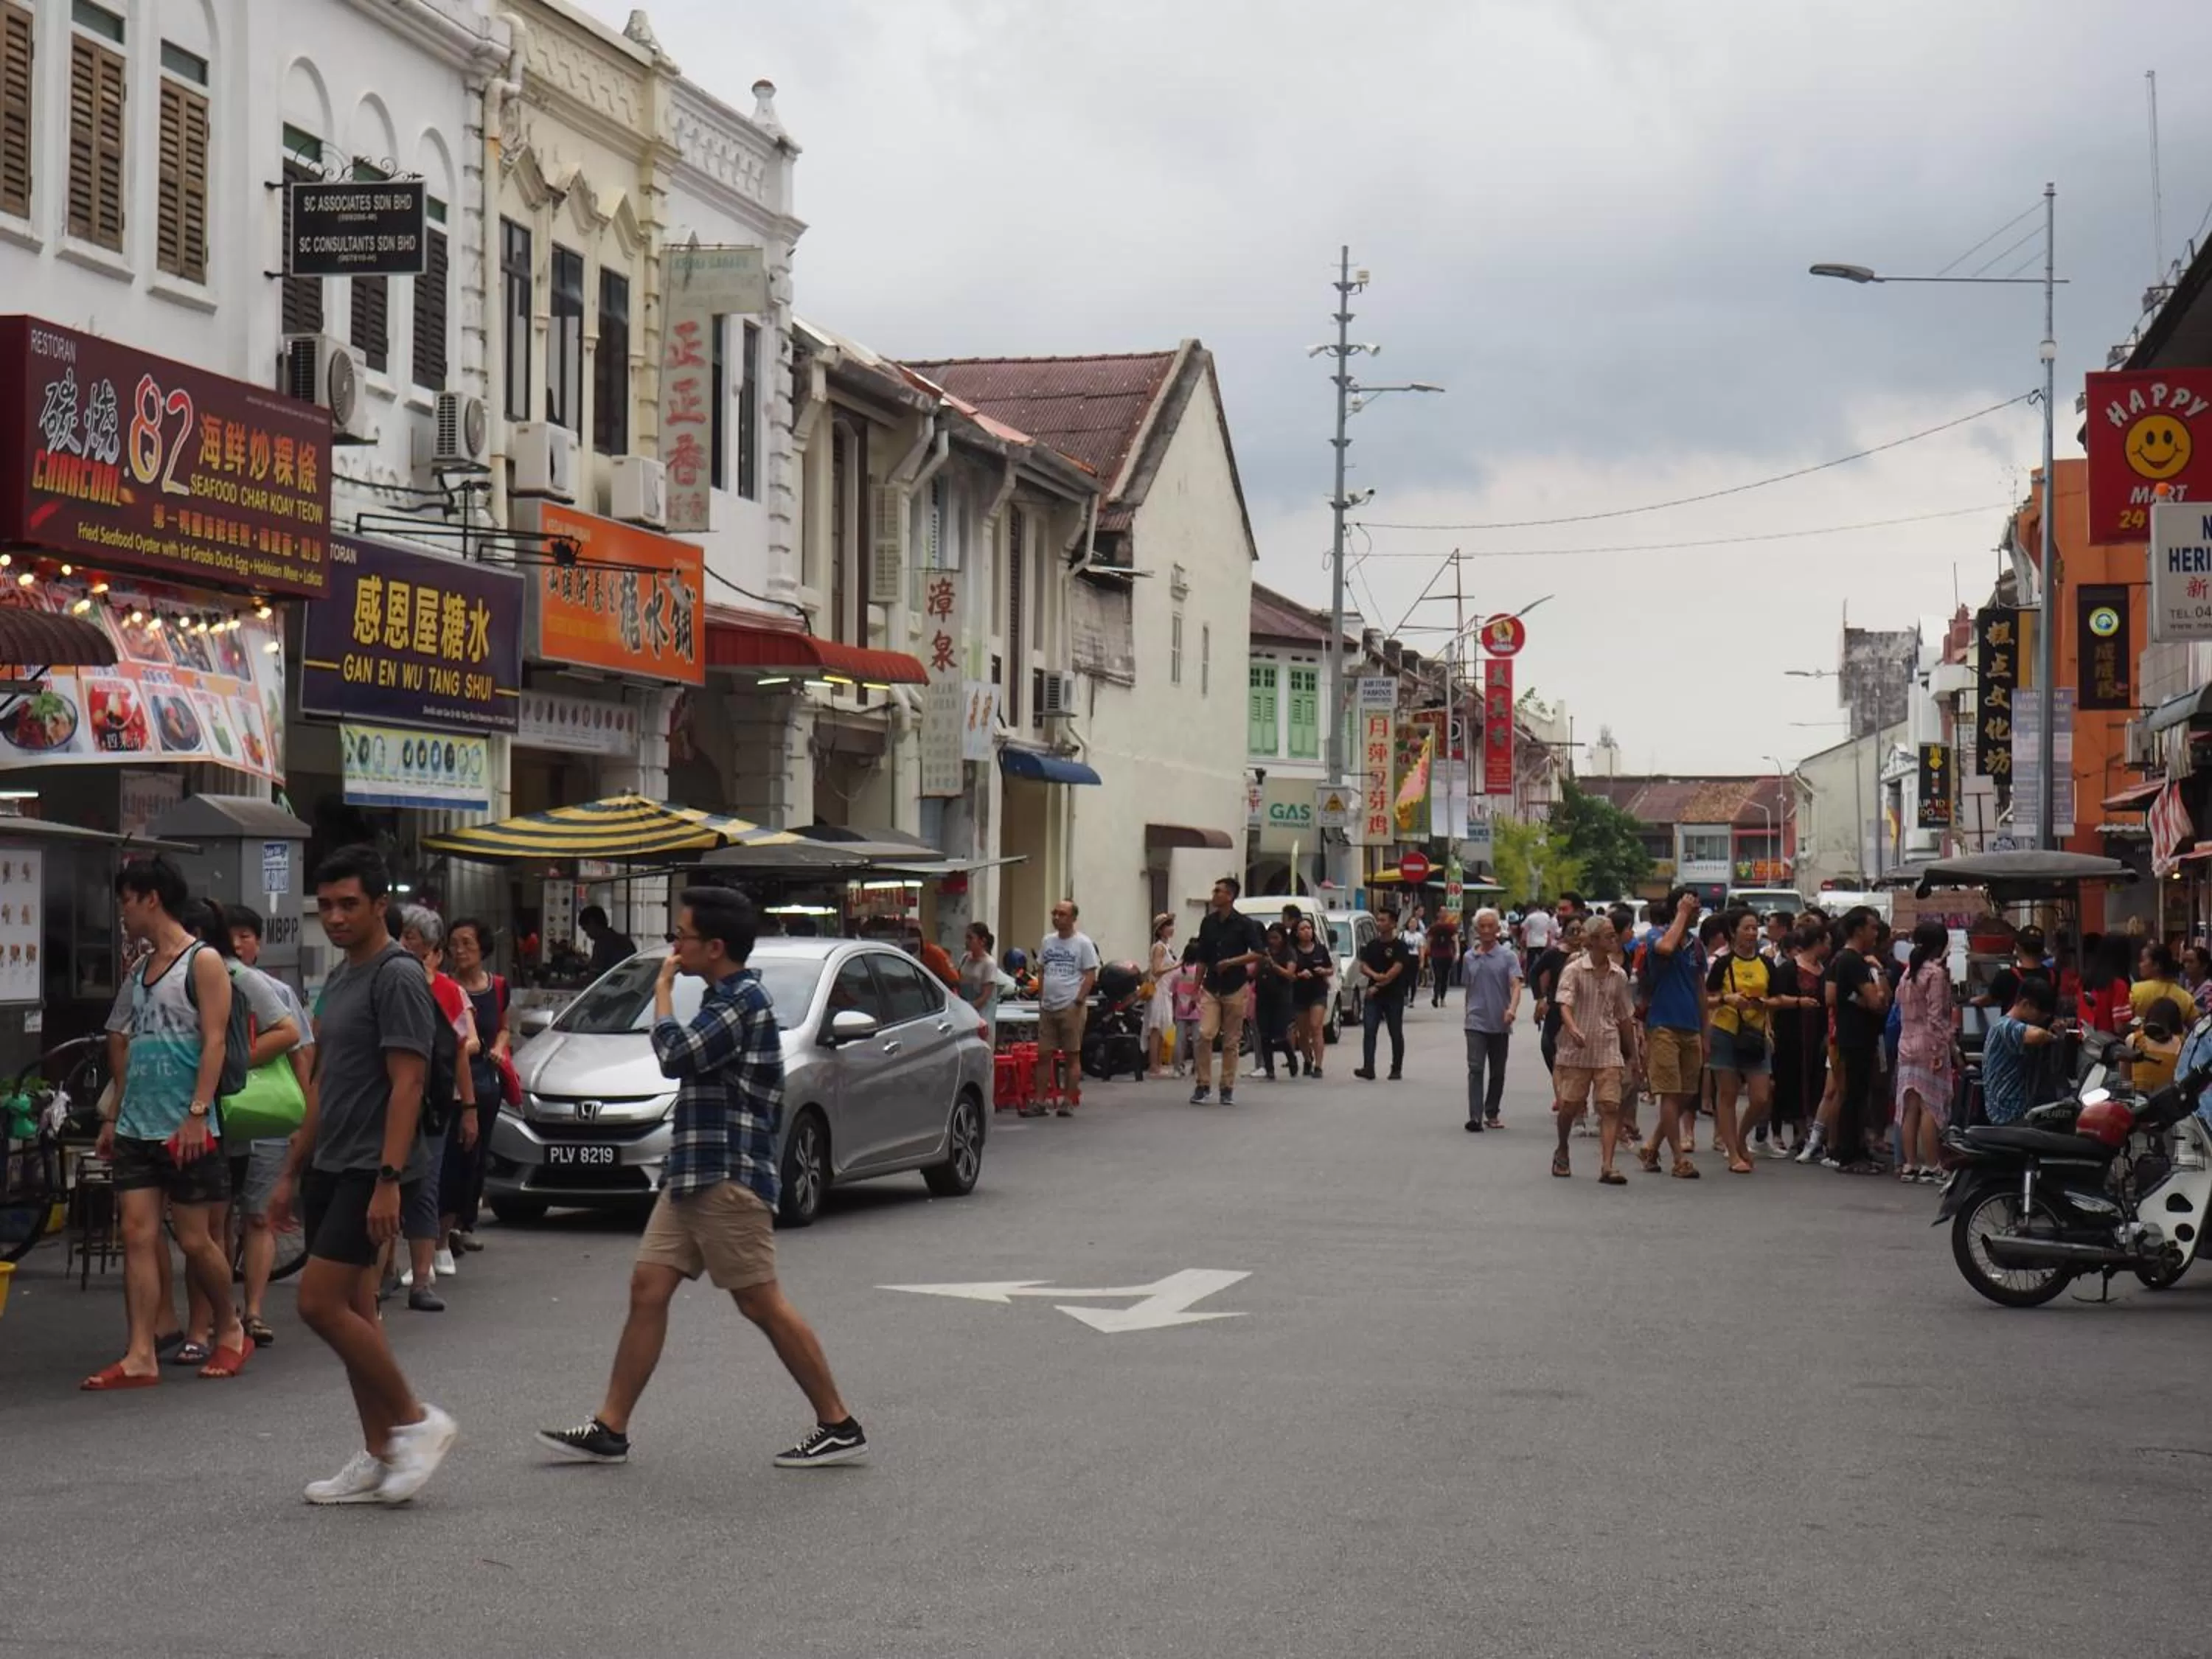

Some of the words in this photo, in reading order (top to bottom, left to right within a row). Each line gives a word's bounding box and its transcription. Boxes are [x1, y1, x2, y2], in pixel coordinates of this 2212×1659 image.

[304, 195, 316, 212] SC
[318, 195, 371, 212] ASSOCIATES
[373, 194, 392, 210] SDN
[394, 193, 412, 210] BHD
[299, 237, 311, 252] SC
[313, 236, 375, 252] CONSULTANTS
[377, 235, 396, 251] SDN
[397, 235, 416, 251] BHD
[31, 330, 76, 364] RESTORAN
[2104, 382, 2209, 428] HAPPY
[129, 373, 193, 496] 82
[190, 473, 237, 504] SEAFOOD
[240, 485, 268, 509] CHAR
[271, 494, 295, 517] KOAY
[296, 499, 324, 524] TEOW
[2118, 509, 2146, 529] 24
[100, 524, 134, 550] Seafood
[352, 574, 491, 663] 感恩屋糖水
[927, 577, 959, 672] 漳泉
[343, 653, 372, 684] GAN
[378, 660, 397, 688] EN
[403, 664, 422, 692] WU
[428, 667, 459, 697] TANG
[465, 672, 492, 701] SHUI
[1269, 802, 1310, 821] GAS
[266, 917, 299, 945] MBPP
[550, 1147, 576, 1164] PLV
[580, 1146, 613, 1164] 8219
